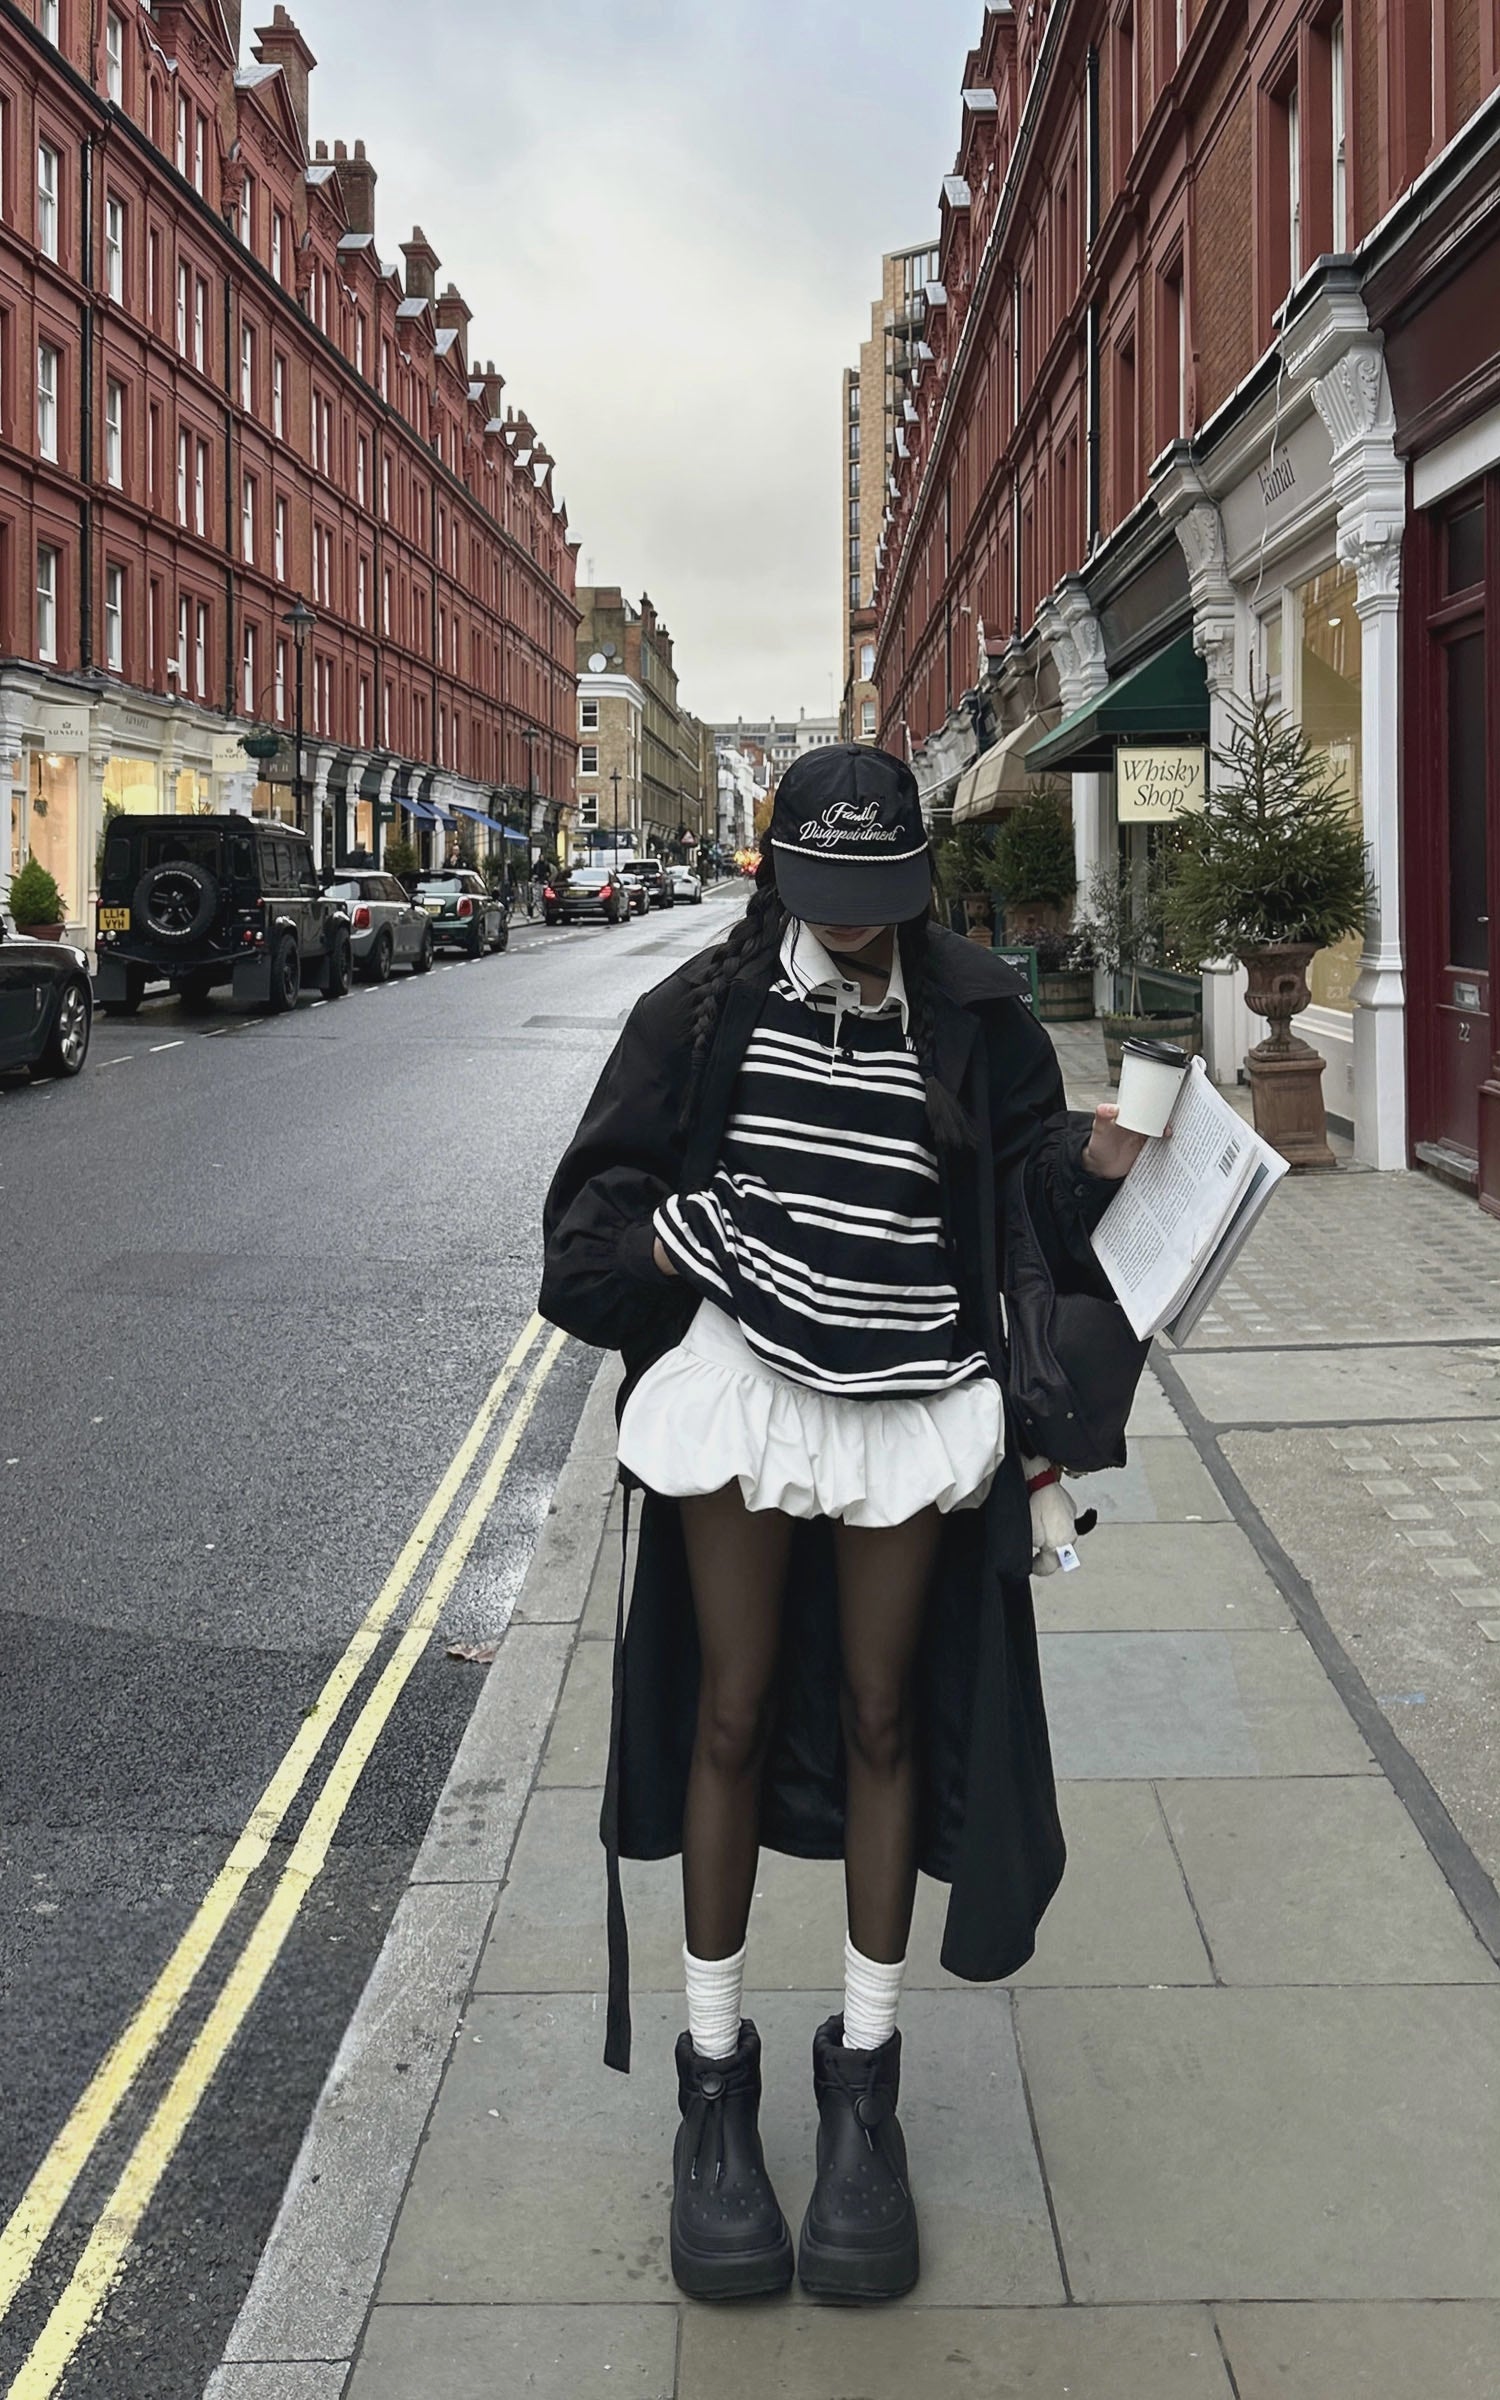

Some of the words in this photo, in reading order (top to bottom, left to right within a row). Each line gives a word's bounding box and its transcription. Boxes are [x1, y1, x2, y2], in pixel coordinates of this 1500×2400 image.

[1122, 758, 1200, 788] Whisky
[1133, 783, 1184, 813] Shop
[821, 801, 880, 829] Family
[799, 820, 906, 848] Disappointment
[103, 910, 126, 919] LL14
[105, 919, 125, 929] VYH
[1458, 1022, 1471, 1042] 22
